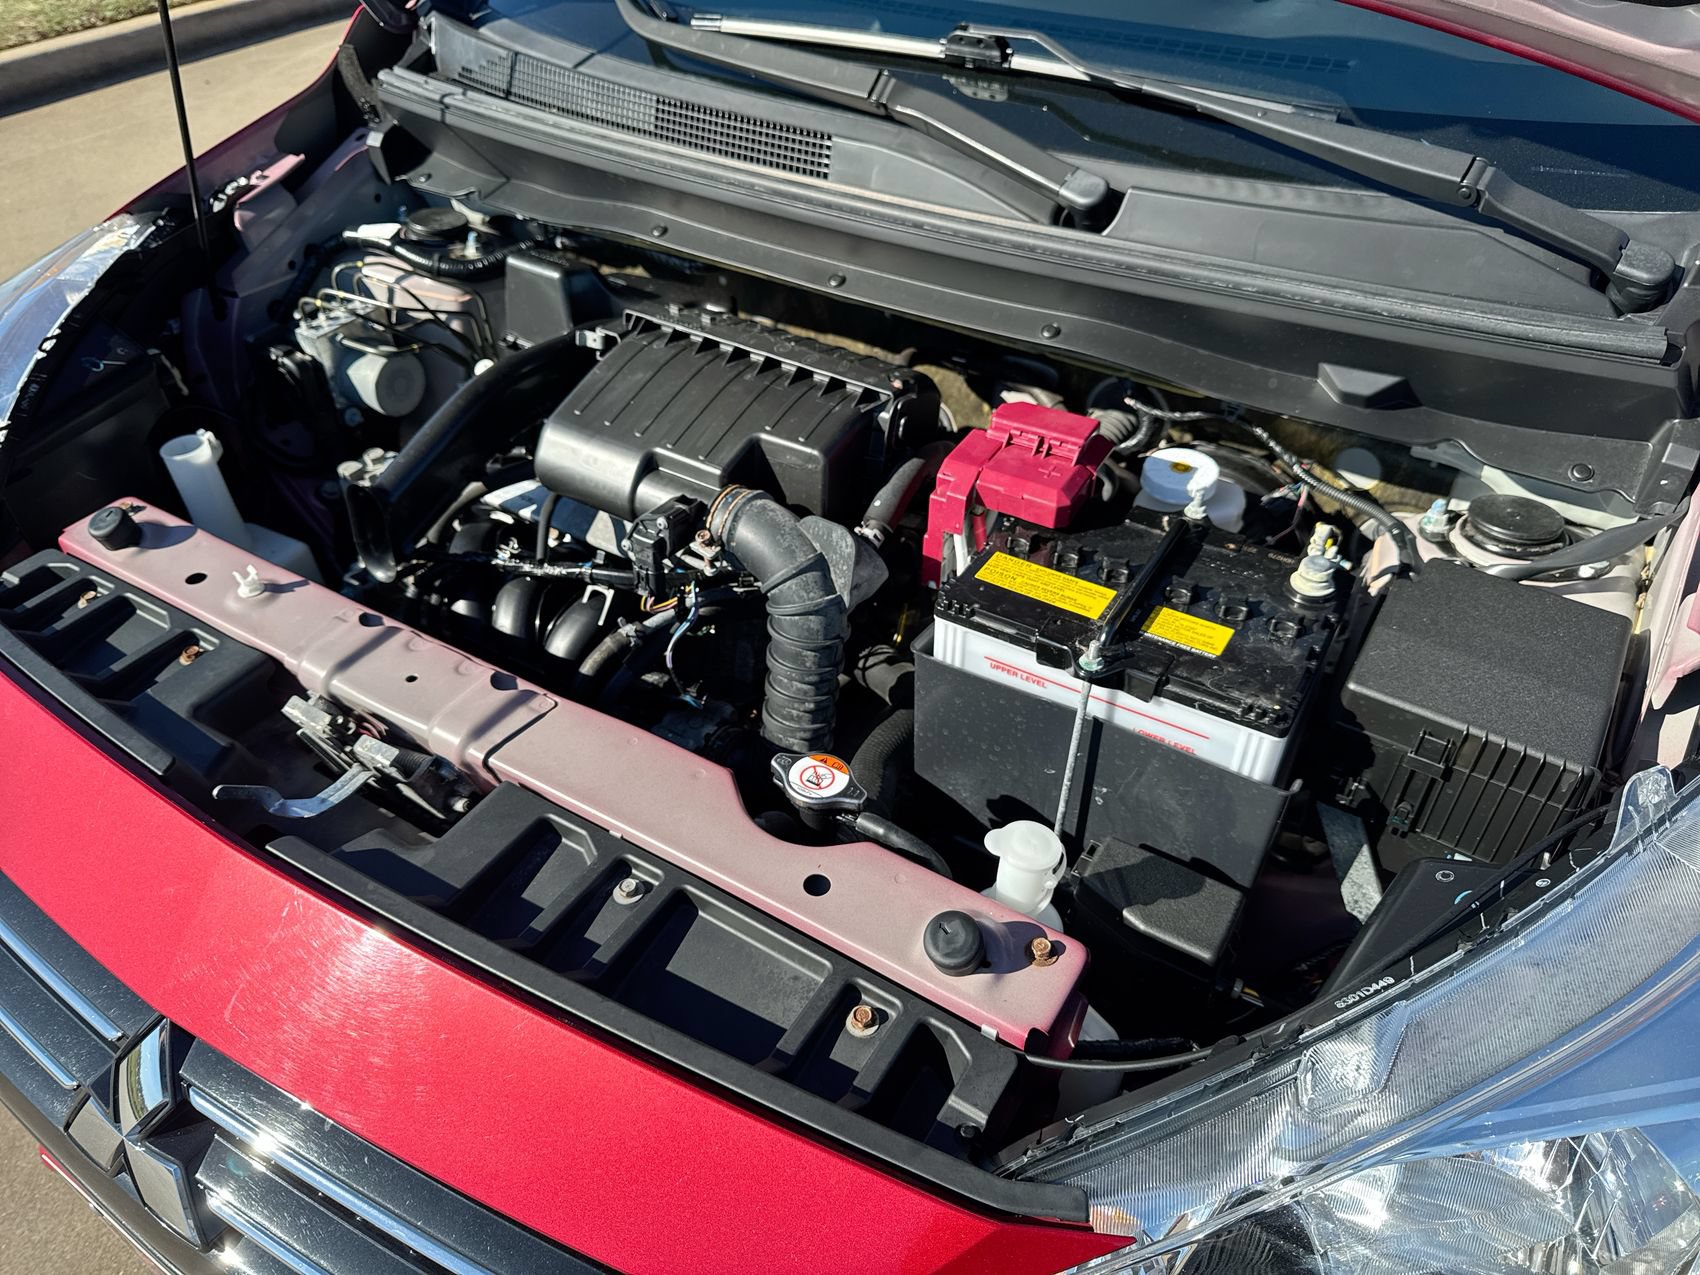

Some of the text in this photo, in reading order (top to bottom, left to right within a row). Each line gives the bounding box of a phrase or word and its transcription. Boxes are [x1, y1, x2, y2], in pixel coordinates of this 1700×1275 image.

[995, 553, 1032, 568] DANGER
[984, 566, 1017, 581] POISON
[1191, 647, 1217, 659] BATTERY
[990, 662, 1047, 689] UPPER LEVEL
